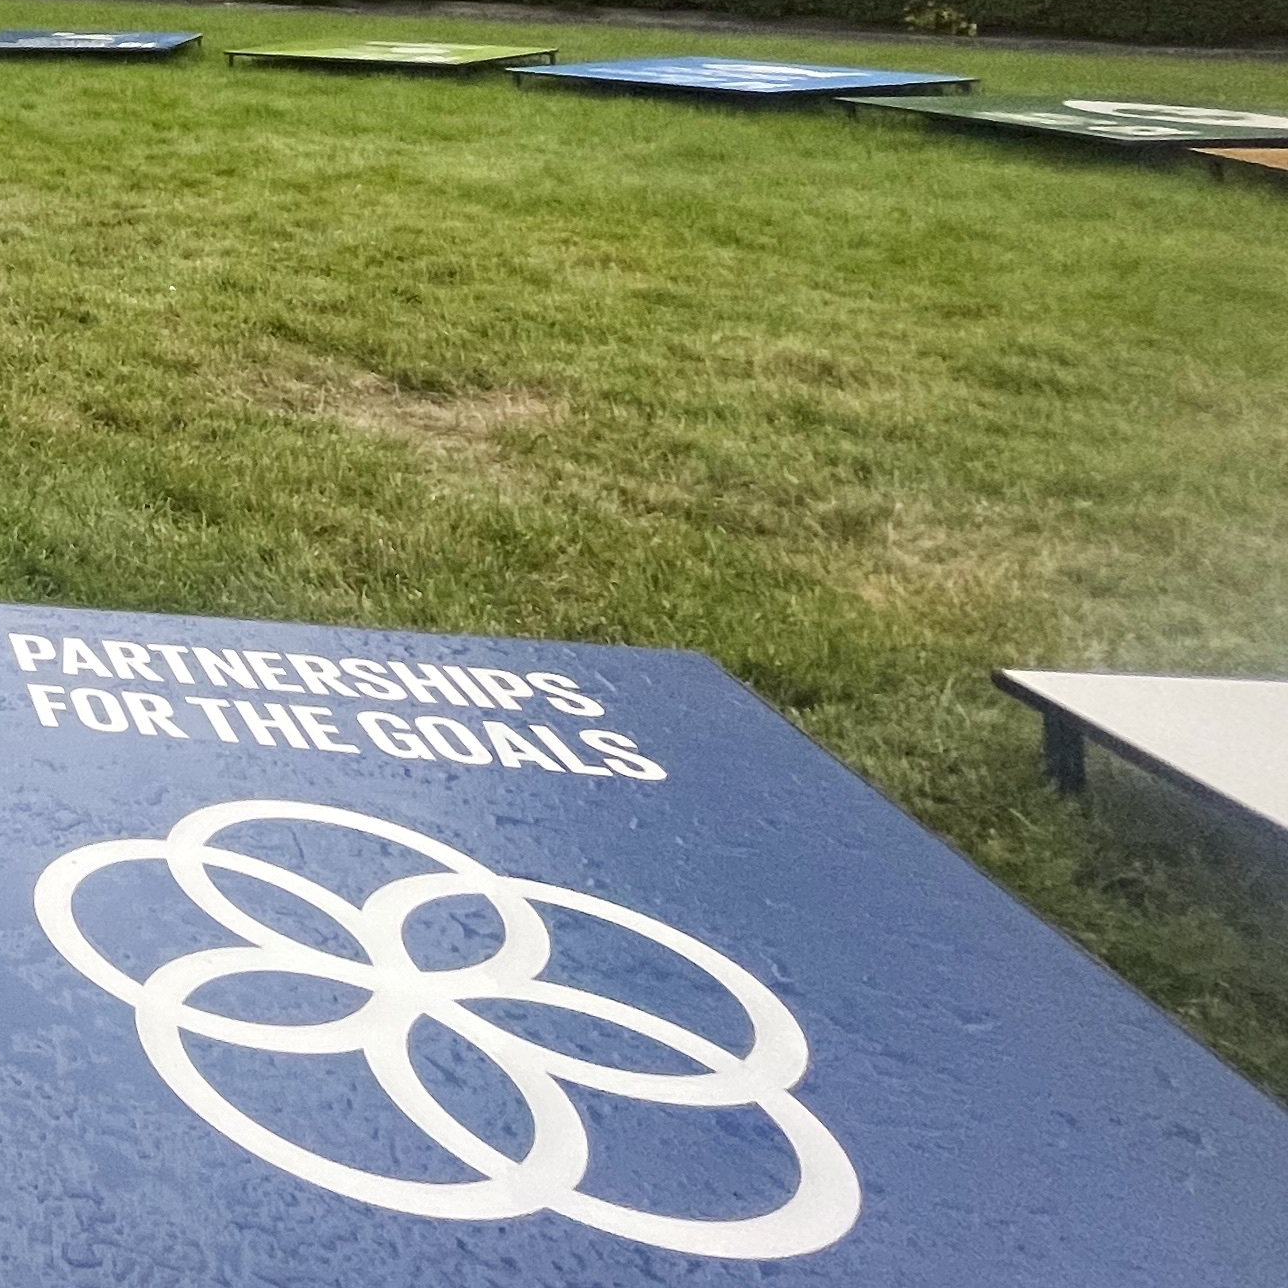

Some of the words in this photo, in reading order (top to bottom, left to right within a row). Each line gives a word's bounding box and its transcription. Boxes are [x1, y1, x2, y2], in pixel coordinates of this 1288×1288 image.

[7, 632, 606, 718] PARTNERSHIPS
[26, 683, 191, 740] FOR
[184, 695, 361, 755] THE
[356, 710, 668, 782] GOALS
